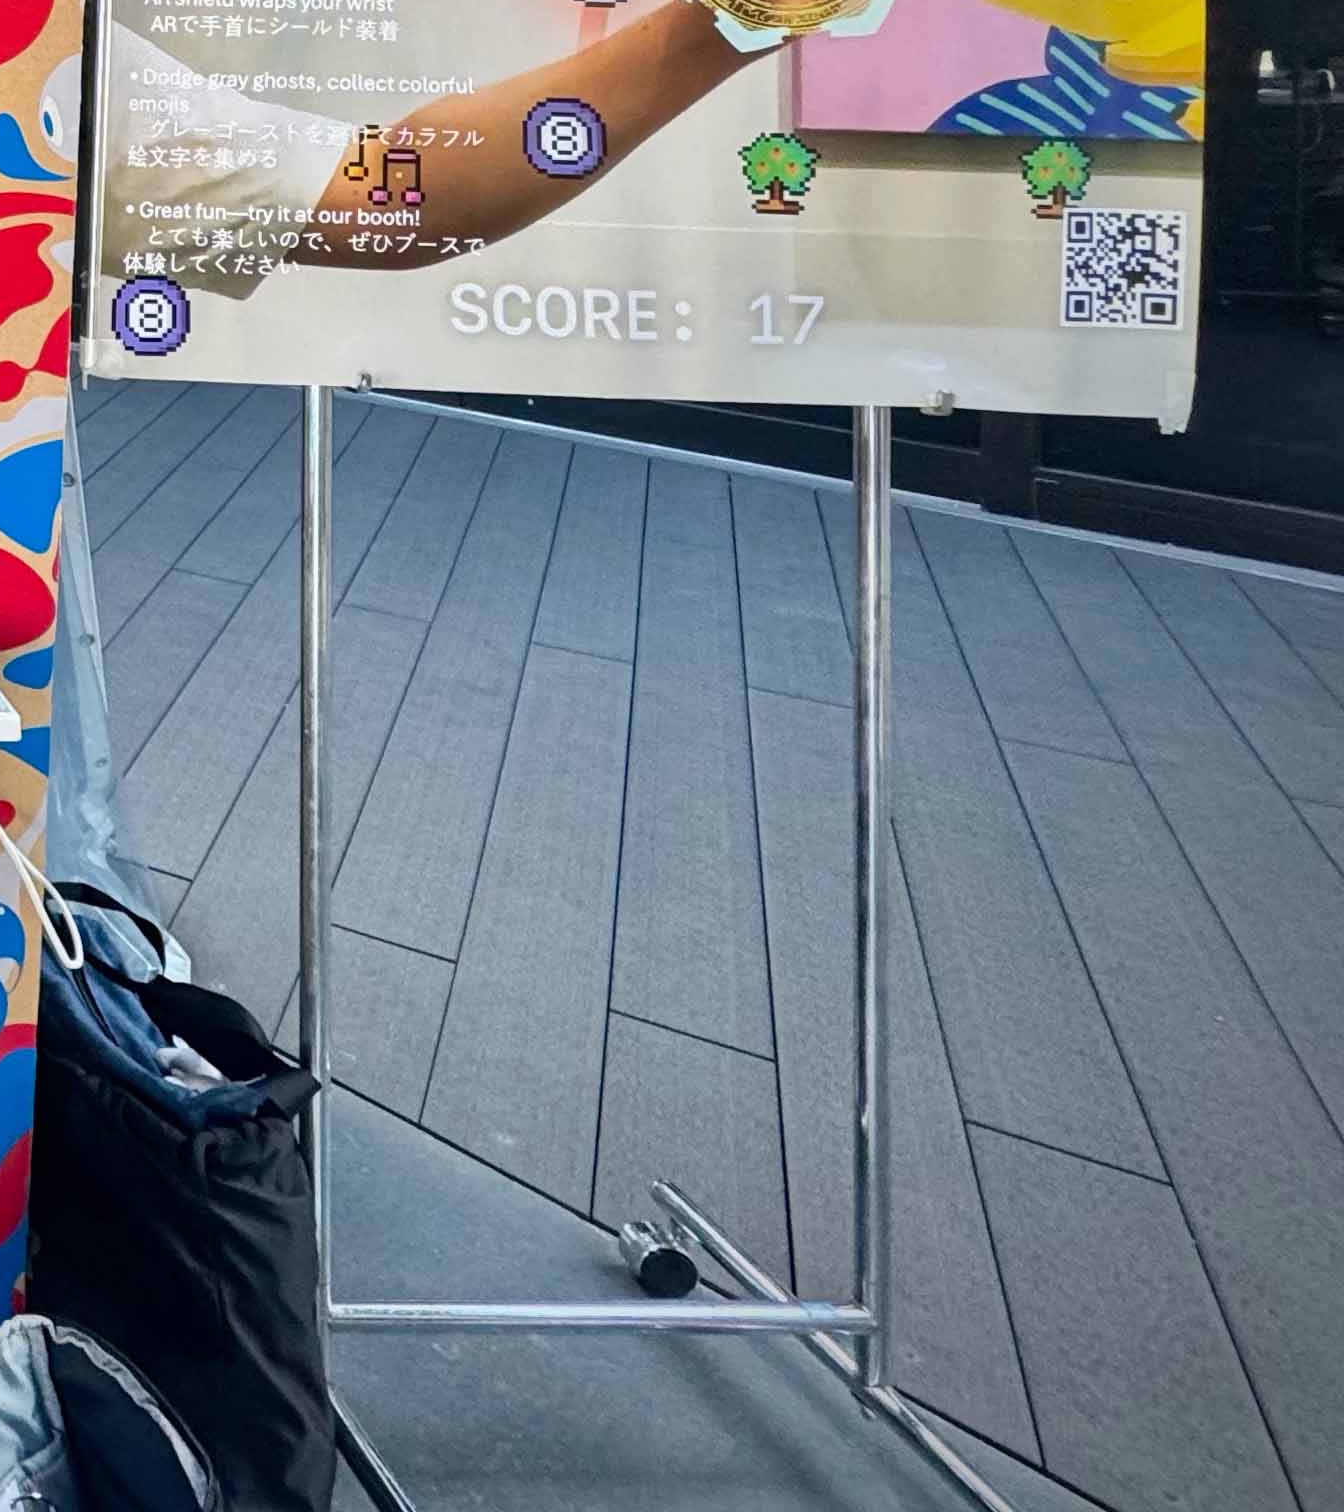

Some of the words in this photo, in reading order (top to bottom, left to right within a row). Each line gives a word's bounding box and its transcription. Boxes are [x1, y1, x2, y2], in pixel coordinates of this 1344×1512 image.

[151, 15, 401, 42] ARで手首にシールド装着
[143, 69, 204, 90] Dodge
[208, 74, 249, 92] gray
[253, 72, 321, 93] ghosts,
[327, 75, 394, 92] collect
[399, 75, 474, 95] colorful
[129, 97, 190, 115] emojis
[127, 145, 278, 169] 絵文字を集める
[139, 202, 191, 219] Great
[277, 206, 290, 222] it
[294, 207, 315, 223] at
[318, 209, 351, 225] our
[357, 208, 421, 227] booth!
[148, 225, 485, 257] とても楽しいので、ぜひブースで
[123, 253, 300, 276] 体験してください
[750, 293, 824, 345] 17
